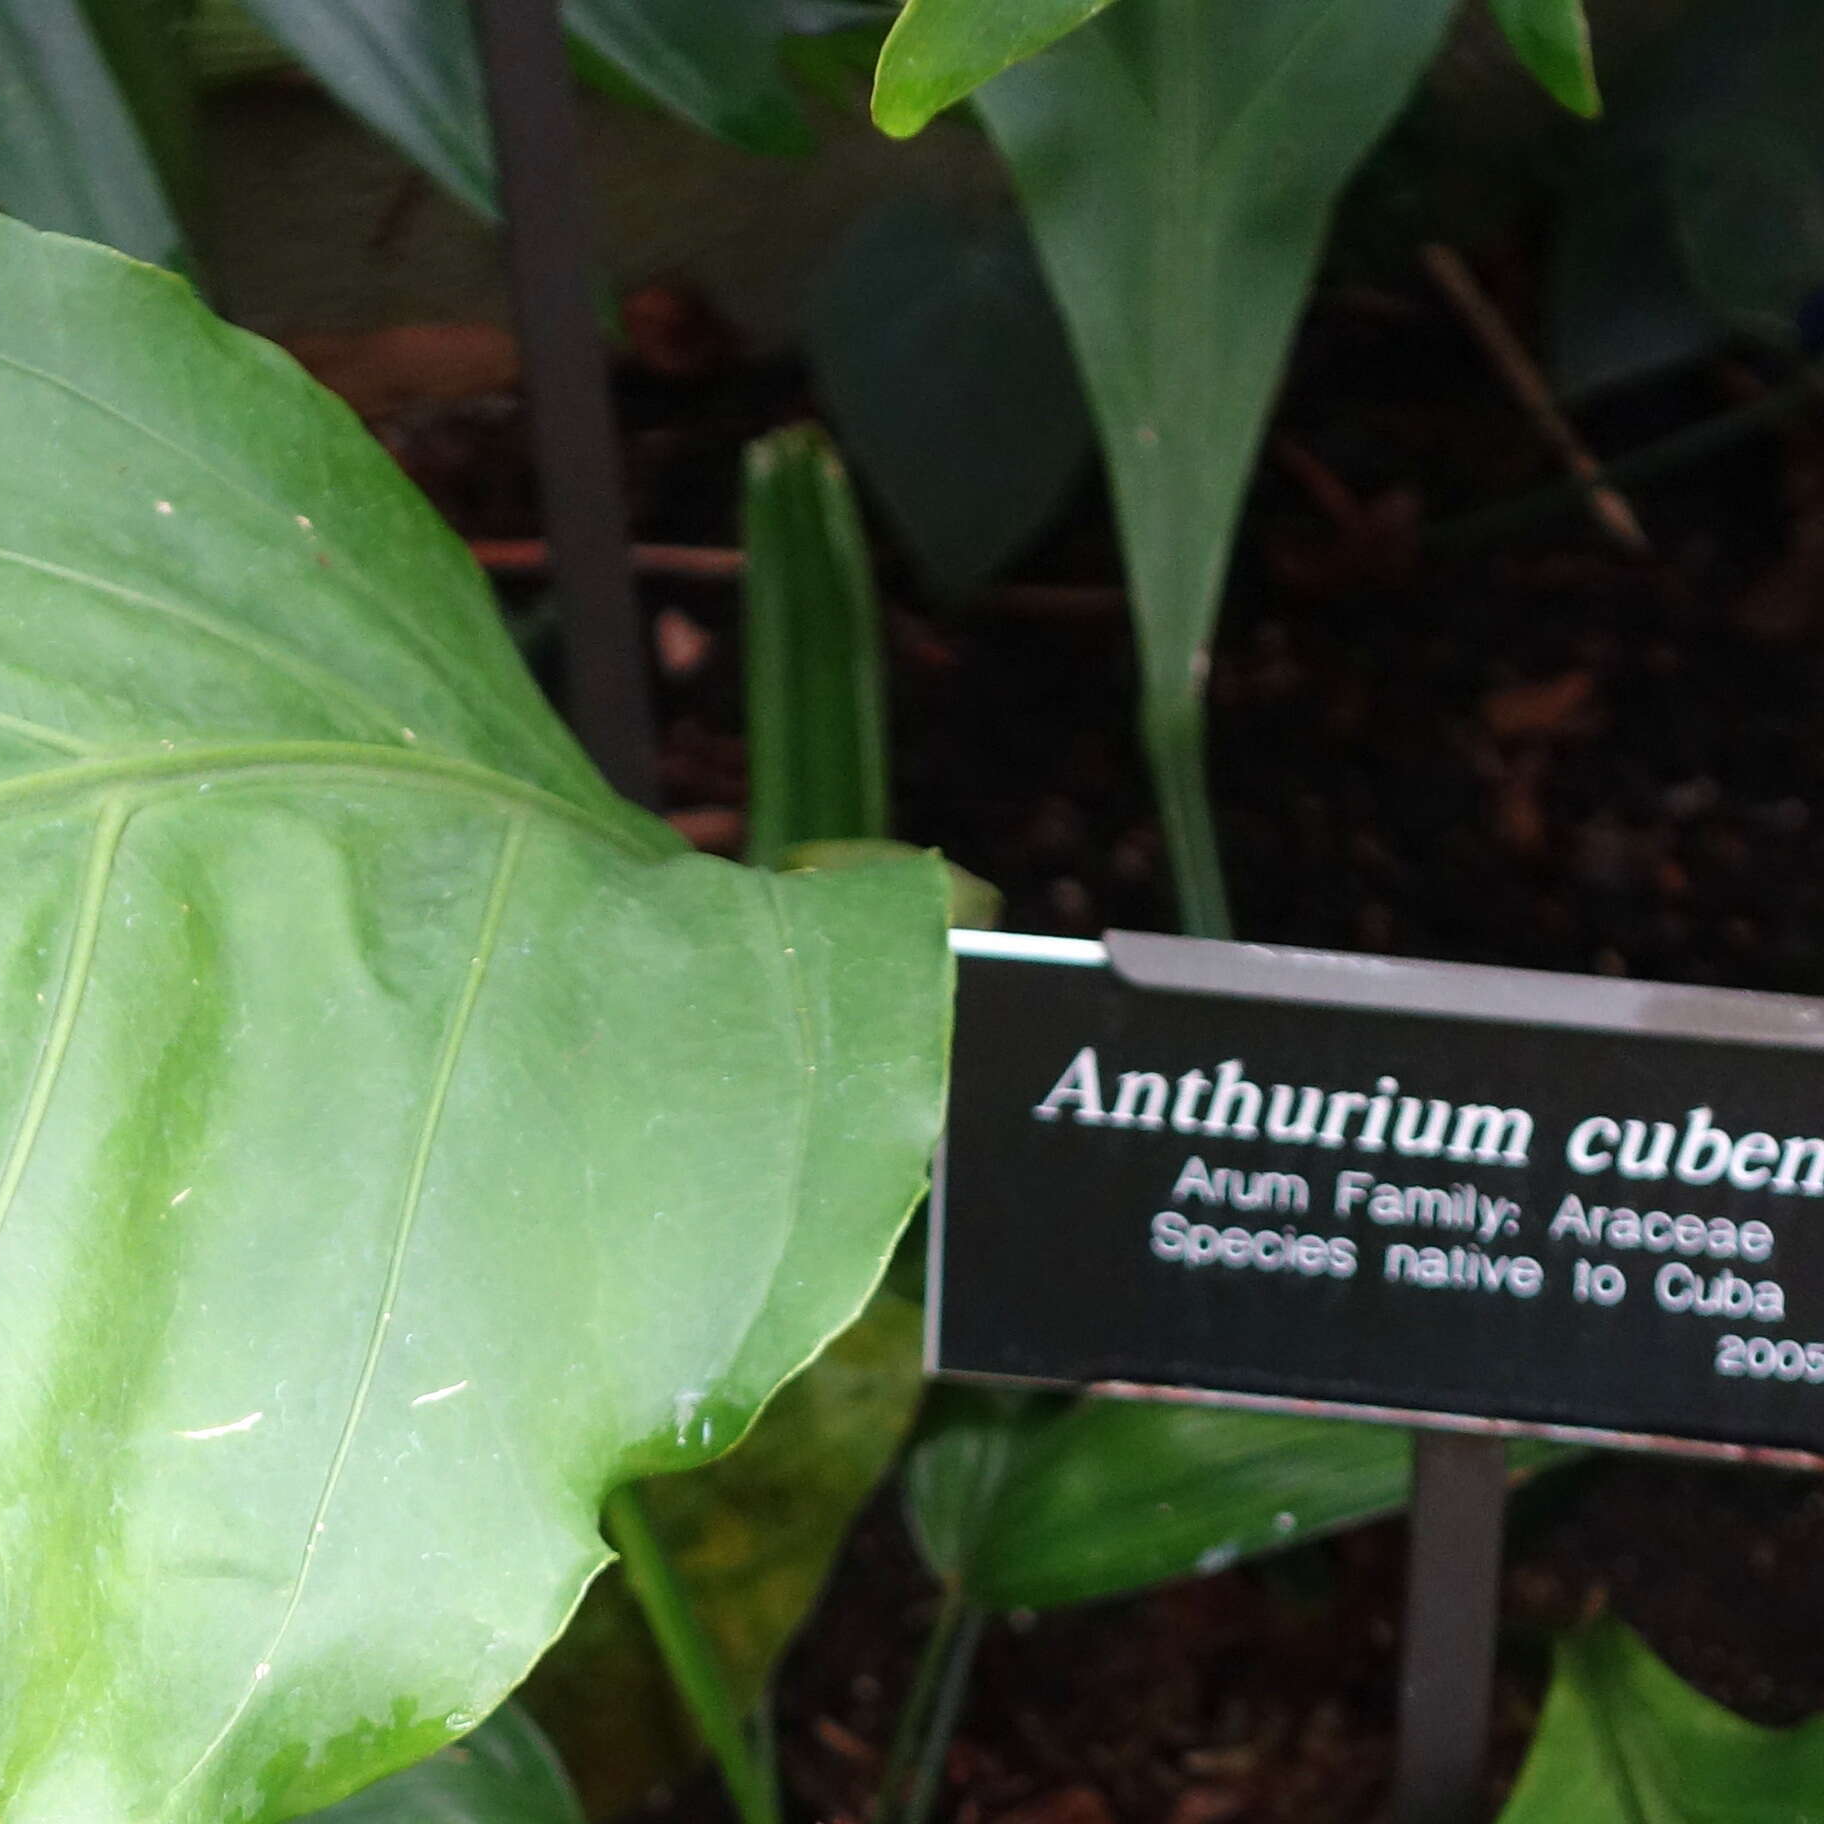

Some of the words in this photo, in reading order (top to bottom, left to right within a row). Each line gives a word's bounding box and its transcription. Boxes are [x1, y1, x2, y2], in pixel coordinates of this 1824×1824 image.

[1035, 1046, 1534, 1169] Anthurium
[1172, 1155, 1310, 1212] Arum
[1334, 1170, 1521, 1242] Family:
[1549, 1193, 1776, 1263] Araceae
[1151, 1210, 1358, 1279] Species
[1384, 1242, 1544, 1300] native
[1573, 1257, 1628, 1307] to
[1654, 1260, 1786, 1323] Cuba
